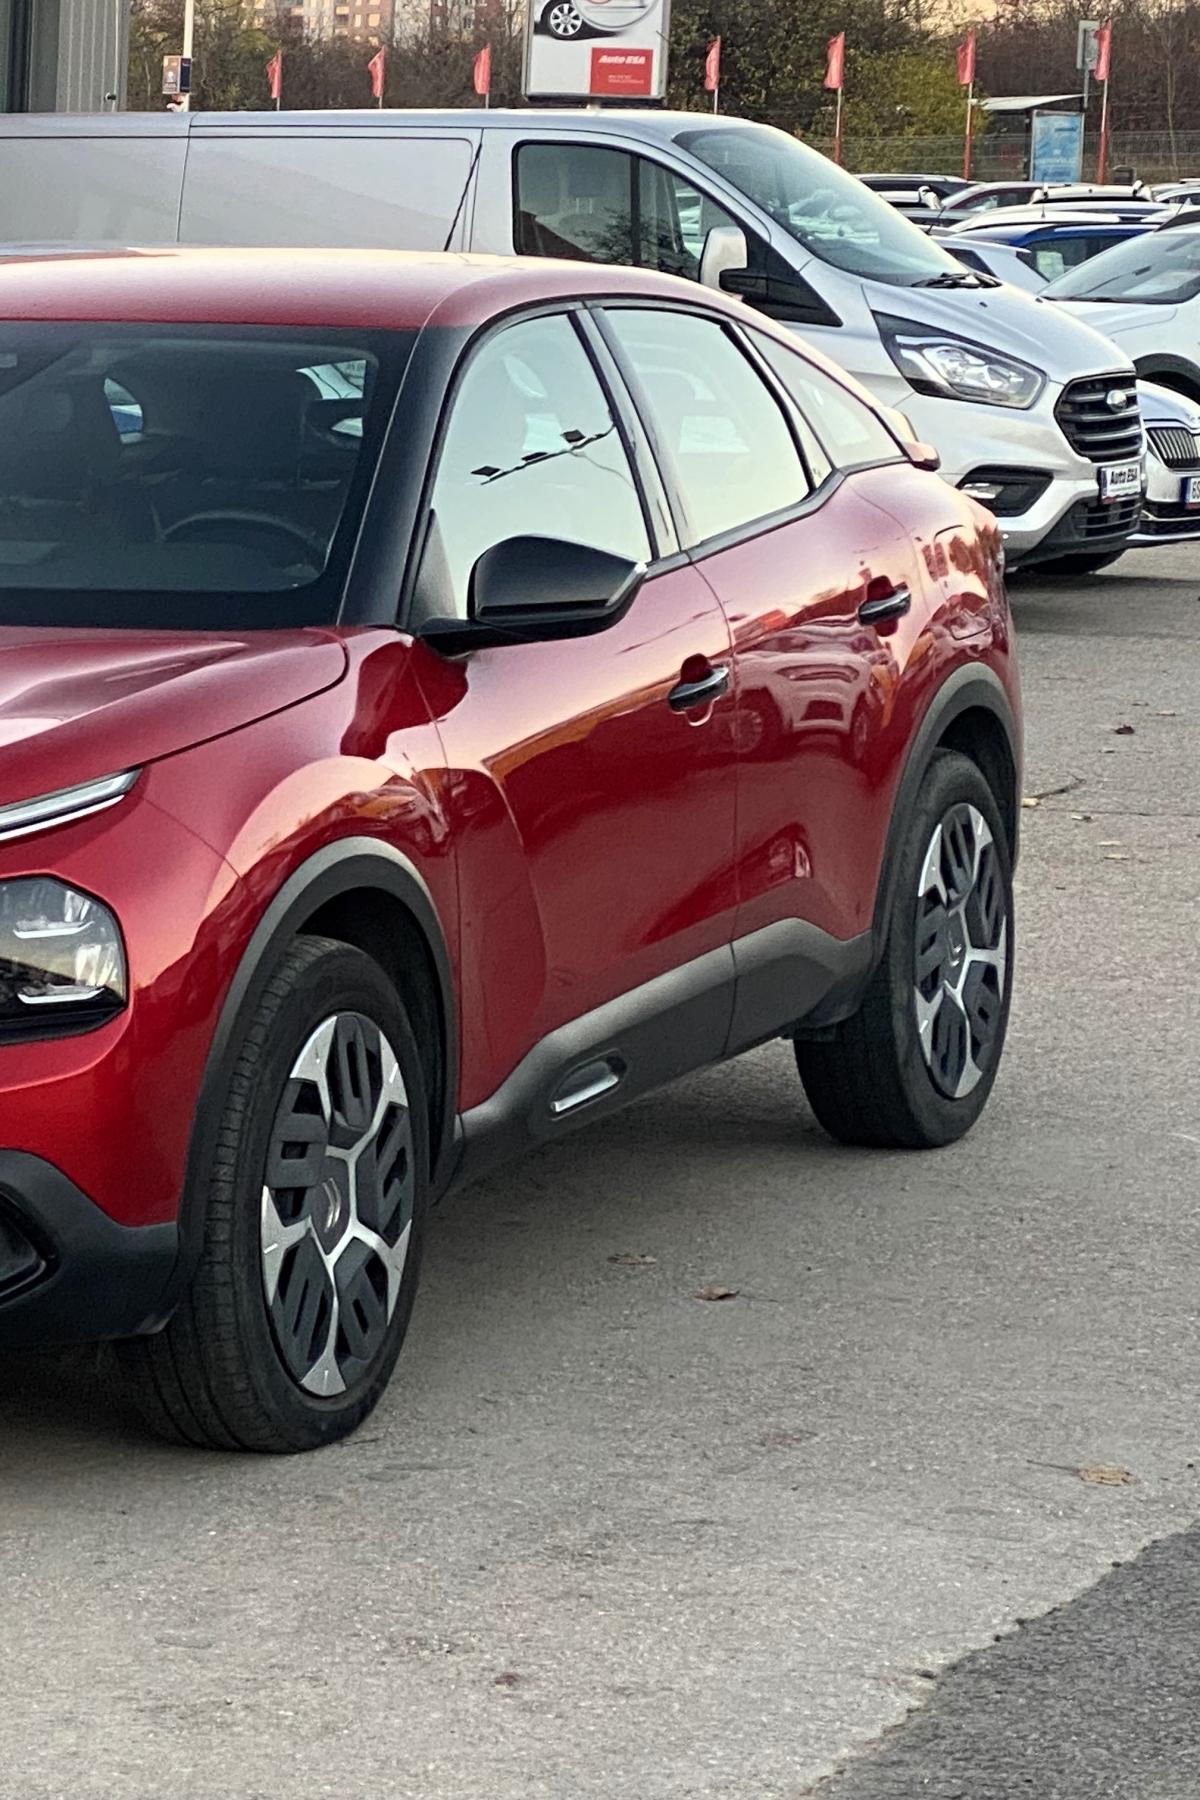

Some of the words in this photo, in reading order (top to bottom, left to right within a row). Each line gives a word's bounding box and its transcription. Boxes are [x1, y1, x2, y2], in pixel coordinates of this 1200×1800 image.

[598, 55, 625, 64] Auto
[626, 56, 646, 65] ESA
[1110, 470, 1127, 486] Auto
[1127, 467, 1138, 483] ESA
